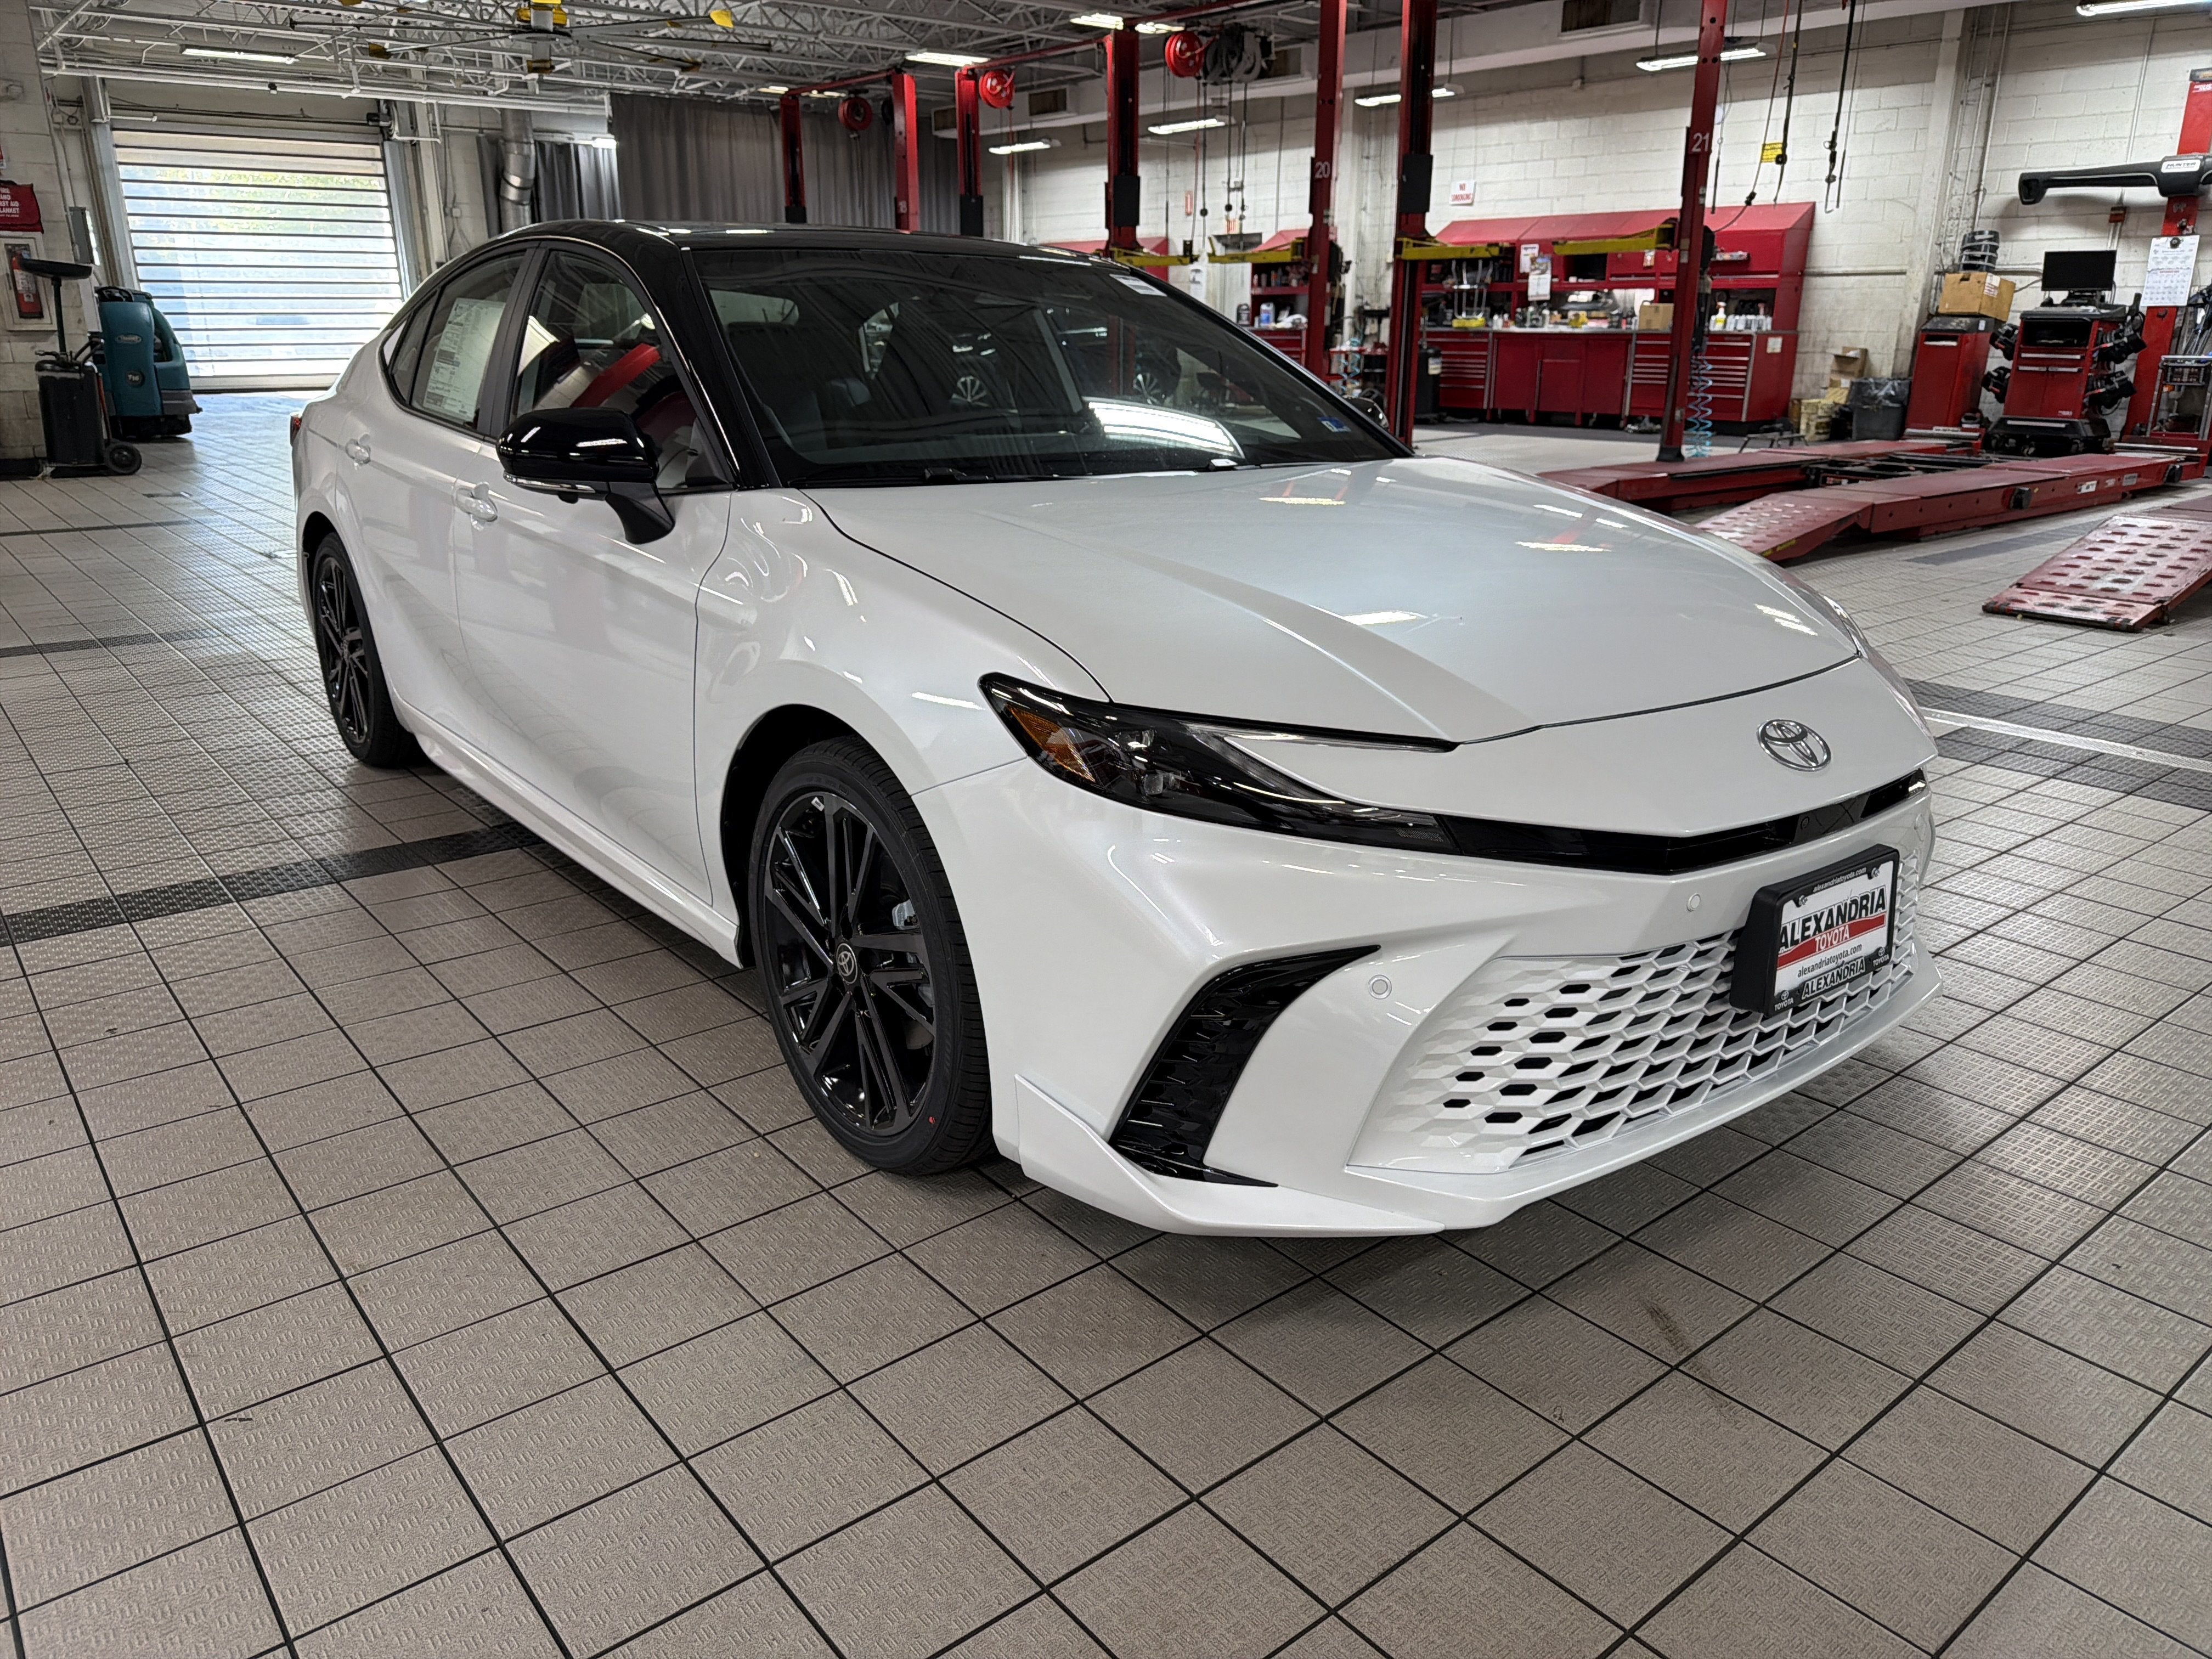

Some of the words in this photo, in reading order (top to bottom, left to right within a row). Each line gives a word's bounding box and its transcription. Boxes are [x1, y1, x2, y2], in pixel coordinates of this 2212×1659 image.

[1692, 132, 1709, 152] 21
[1314, 161, 1331, 179] 20
[1813, 867, 1867, 893] alexandriatoyota.com
[1779, 886, 1886, 952] ALEXANDRIA
[1815, 924, 1850, 952] TOYOTA
[1797, 943, 1863, 978] alexandriatoyota.com
[1872, 953, 1889, 967] TOYOTA
[1802, 958, 1865, 1000] ALEXANDRIA
[1774, 997, 1794, 1011] TOYOTA
